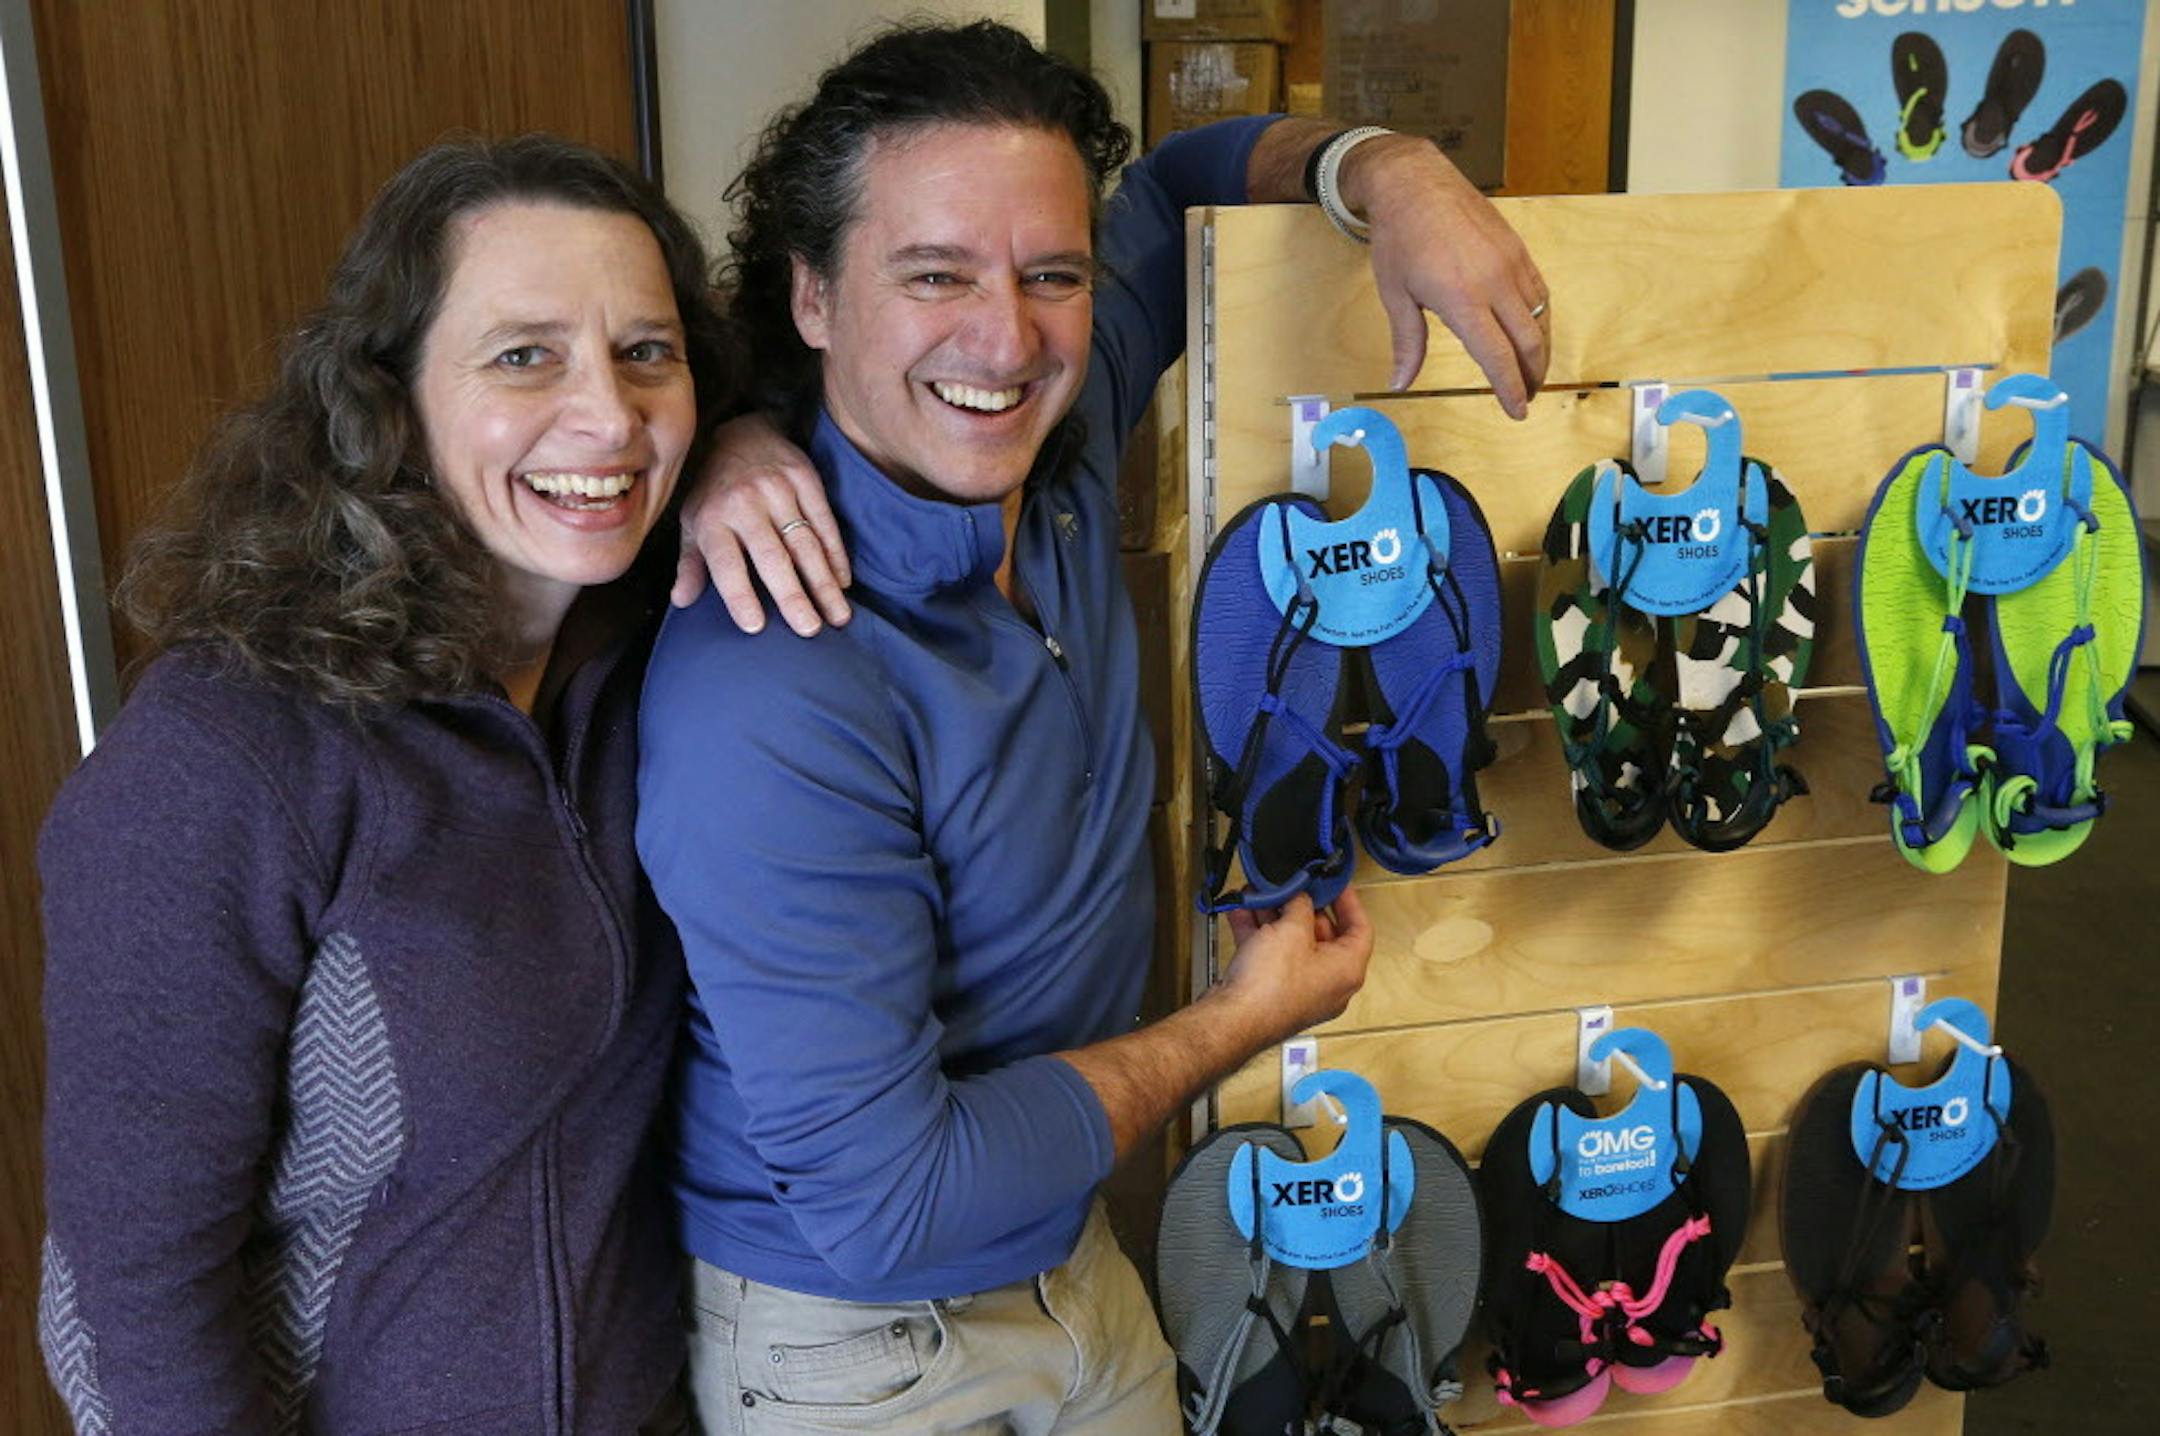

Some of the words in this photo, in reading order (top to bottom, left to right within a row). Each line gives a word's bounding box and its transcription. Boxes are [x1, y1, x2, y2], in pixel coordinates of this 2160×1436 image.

[1960, 489, 2046, 525] XERO
[1634, 507, 1721, 544] XERO
[2003, 525, 2043, 540] SHOES
[1306, 528, 1401, 579] XERO
[1677, 545, 1719, 560] SHOES
[1360, 566, 1405, 586] SHOES
[1890, 1097, 1968, 1131] XERO
[1578, 1125, 1656, 1158] OMG
[1929, 1128, 1966, 1142] SHOES
[1579, 1166, 1592, 1177] to
[1595, 1150, 1656, 1175] barefoot!
[1271, 1172, 1364, 1207] XERO
[1320, 1205, 1364, 1219] SHOES
